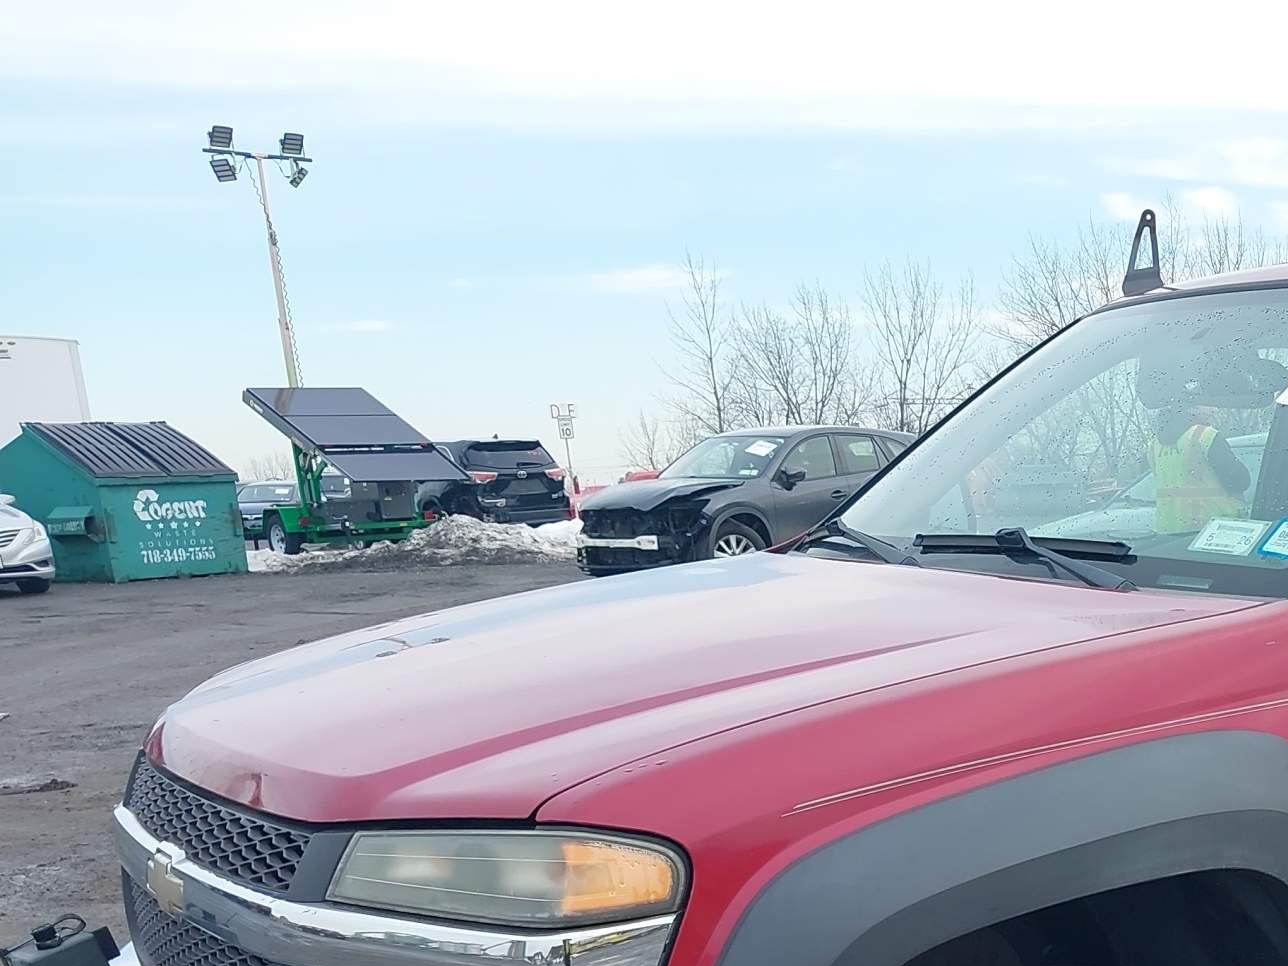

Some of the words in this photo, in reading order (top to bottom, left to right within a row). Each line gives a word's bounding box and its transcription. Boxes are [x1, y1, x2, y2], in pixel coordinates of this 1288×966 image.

[561, 427, 572, 437] 10
[153, 529, 197, 538] WASTE
[139, 538, 214, 549] SOLUTIONS
[140, 546, 216, 564] 718-349-7555
